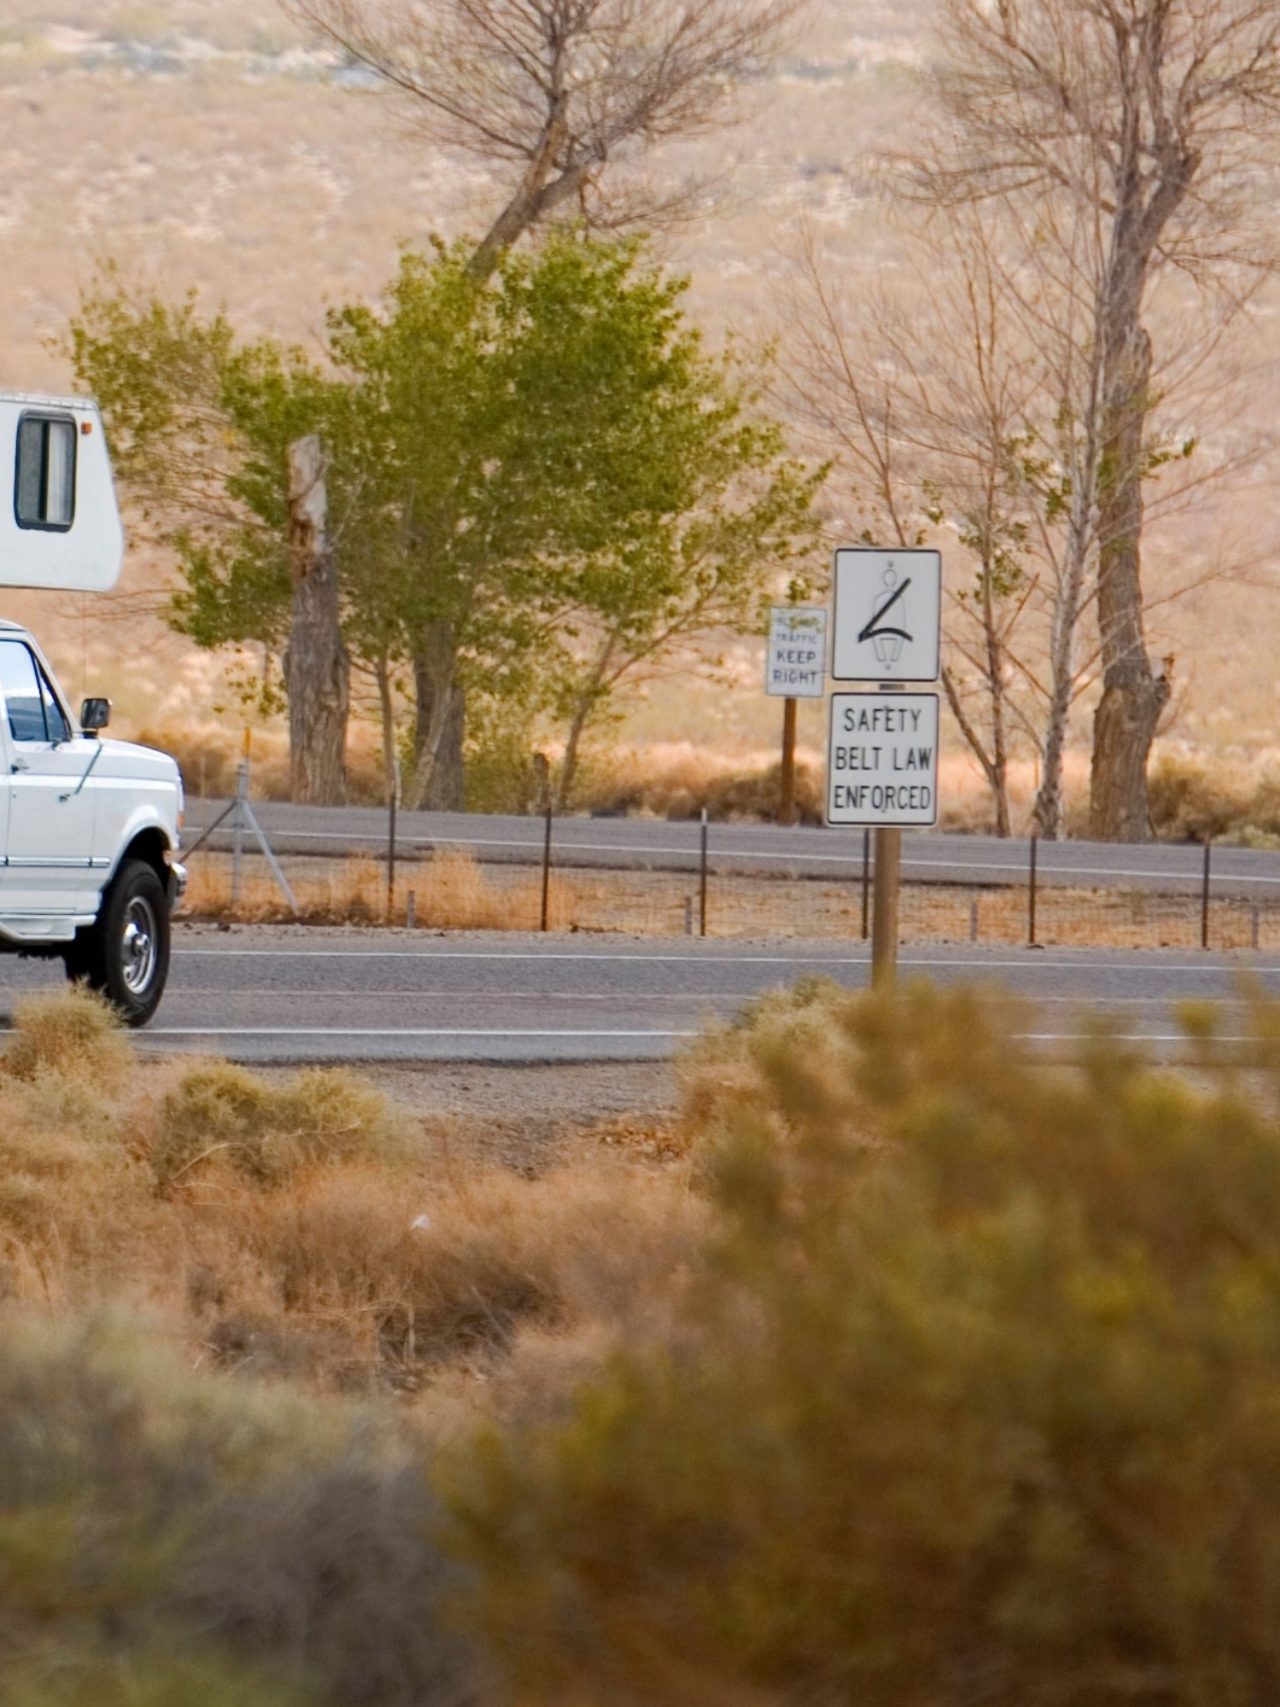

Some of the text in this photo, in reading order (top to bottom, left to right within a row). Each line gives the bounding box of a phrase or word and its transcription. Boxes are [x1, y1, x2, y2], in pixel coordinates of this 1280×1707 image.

[776, 633, 818, 644] TRAFFIC
[777, 650, 816, 664] KEEP
[773, 669, 817, 684] RIGHT
[844, 708, 921, 732] SAFETY
[835, 746, 932, 770] BELT LAW
[834, 785, 931, 809] ENFORCED
